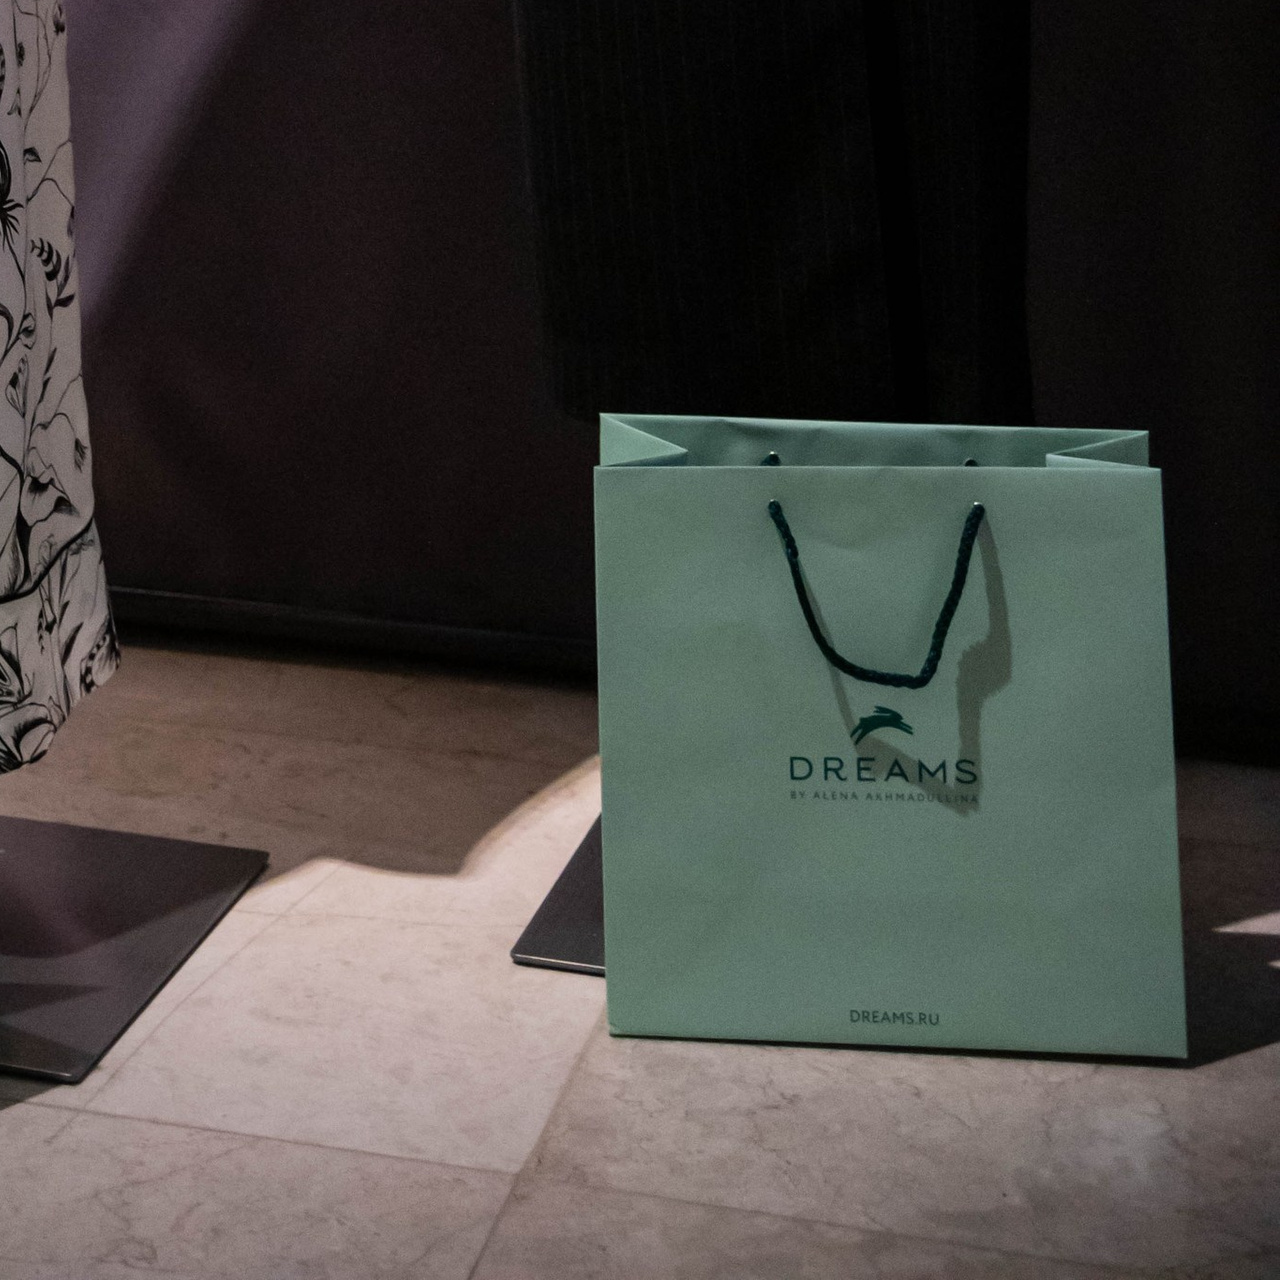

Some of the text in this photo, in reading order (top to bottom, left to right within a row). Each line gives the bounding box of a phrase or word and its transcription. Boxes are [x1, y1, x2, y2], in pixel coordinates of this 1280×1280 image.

[789, 756, 978, 784] DREAMS
[790, 790, 806, 800] BY
[813, 791, 858, 801] ALENA
[849, 1009, 940, 1026] DREAMS.RU
